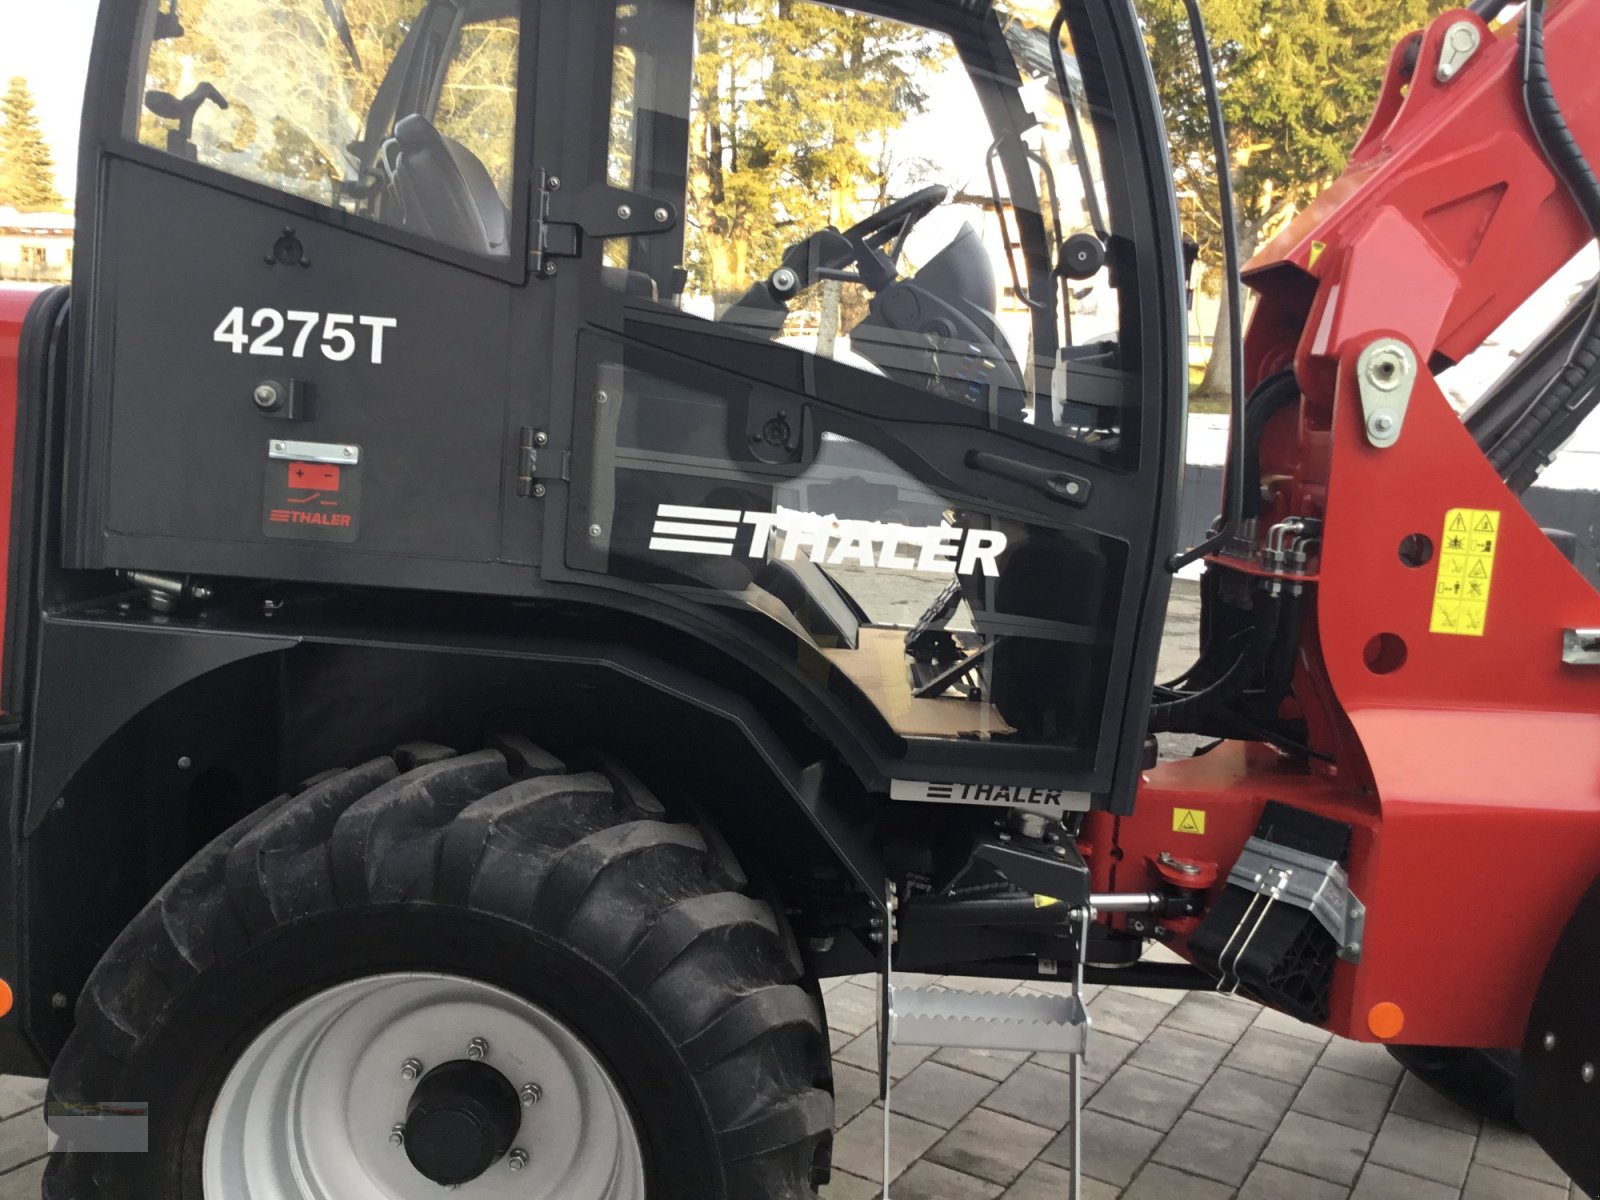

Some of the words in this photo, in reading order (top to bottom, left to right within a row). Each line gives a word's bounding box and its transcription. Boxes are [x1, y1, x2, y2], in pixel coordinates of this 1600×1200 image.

[213, 306, 397, 364] 4275T
[290, 510, 351, 527] THALER
[742, 509, 1008, 577] THALER
[959, 783, 1061, 805] THALER
